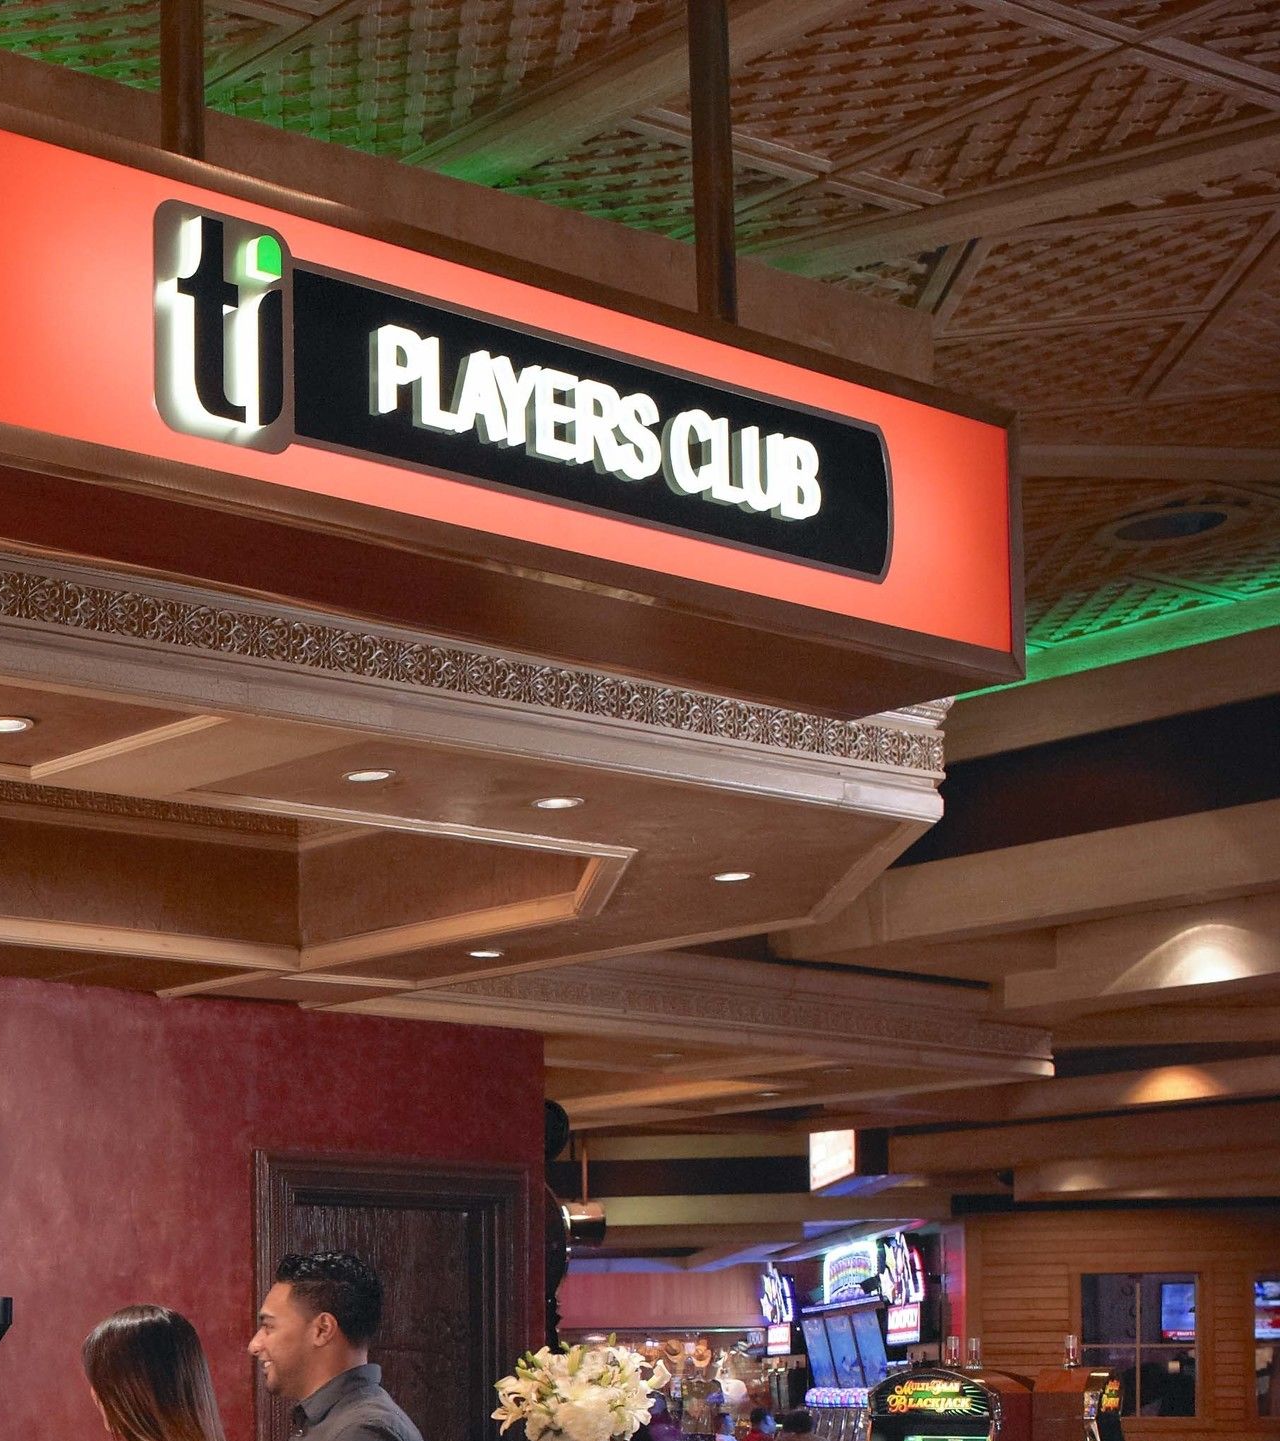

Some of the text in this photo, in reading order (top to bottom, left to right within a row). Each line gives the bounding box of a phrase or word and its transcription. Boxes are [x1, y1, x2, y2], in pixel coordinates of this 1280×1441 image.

[158, 214, 283, 432] ti
[369, 322, 822, 520] PLAYERS CLUB
[887, 1394, 972, 1414] BLACKJACK
